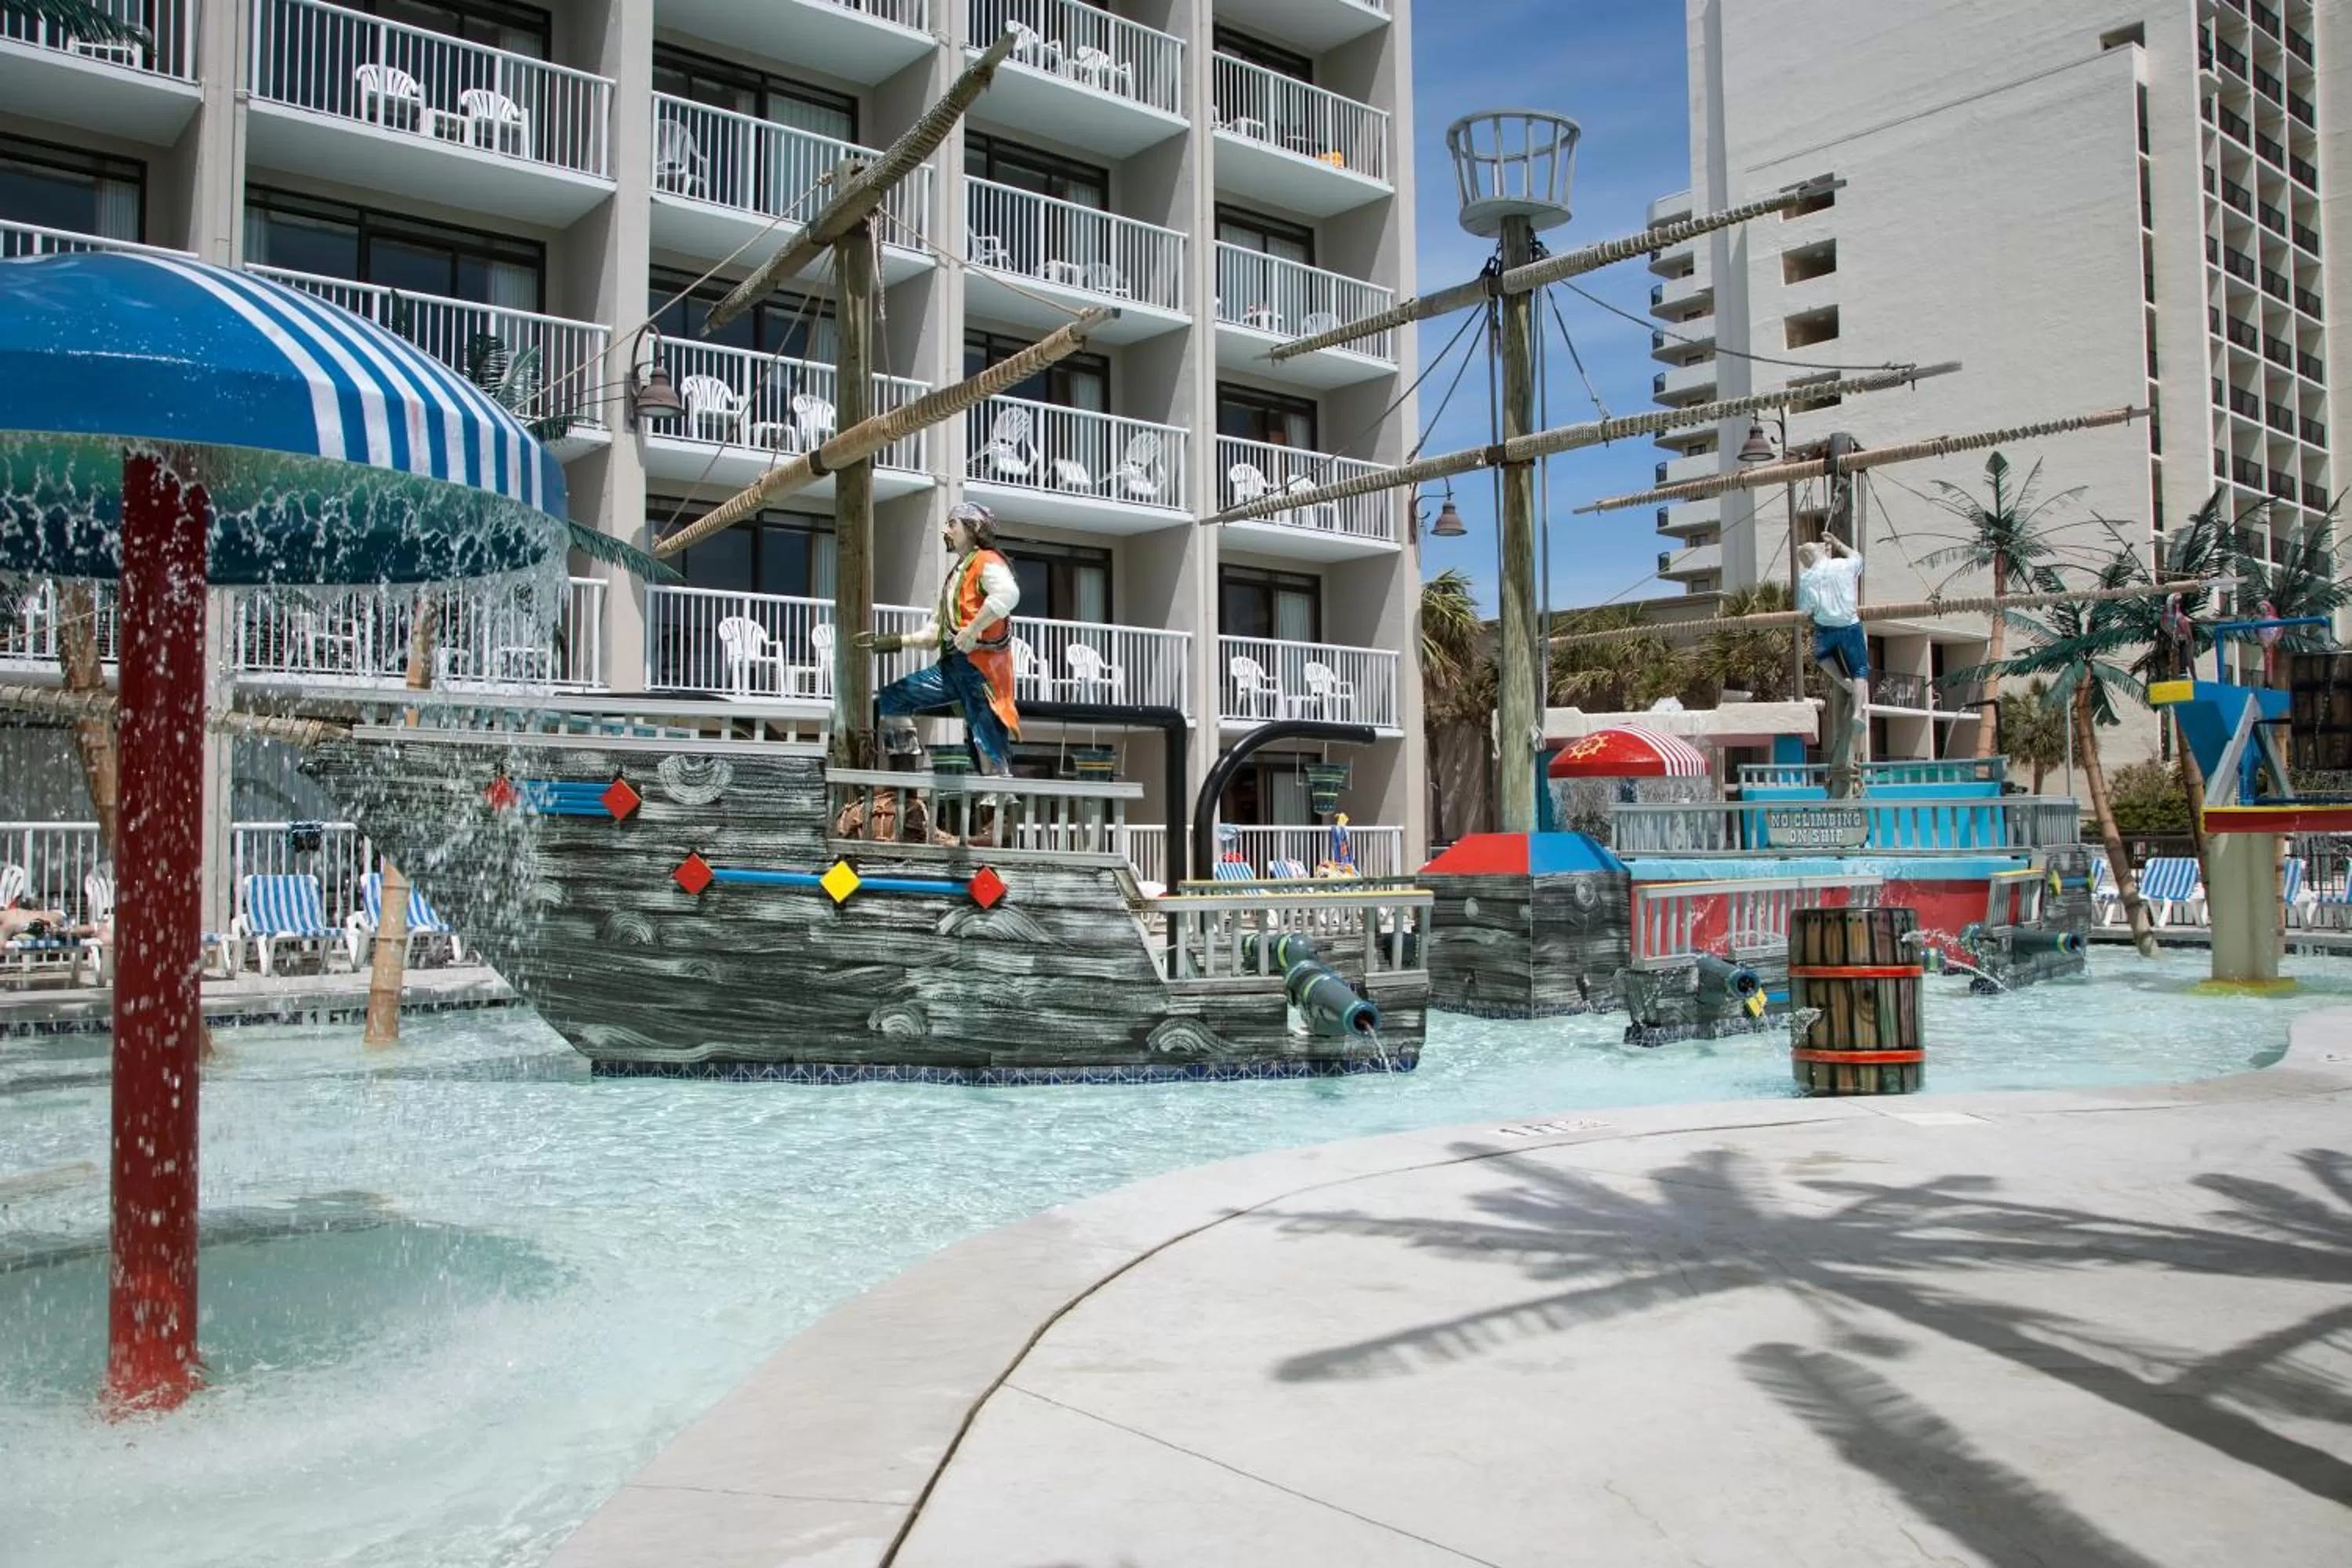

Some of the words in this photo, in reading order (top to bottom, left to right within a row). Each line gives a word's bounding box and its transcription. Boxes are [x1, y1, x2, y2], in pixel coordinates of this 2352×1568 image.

[1771, 813, 1788, 827] NO
[1794, 812, 1860, 827] CLIMBING
[1790, 829, 1807, 844] ON
[1812, 829, 1843, 844] SHIP
[310, 1010, 318, 1025] 1
[329, 1008, 350, 1024] FT
